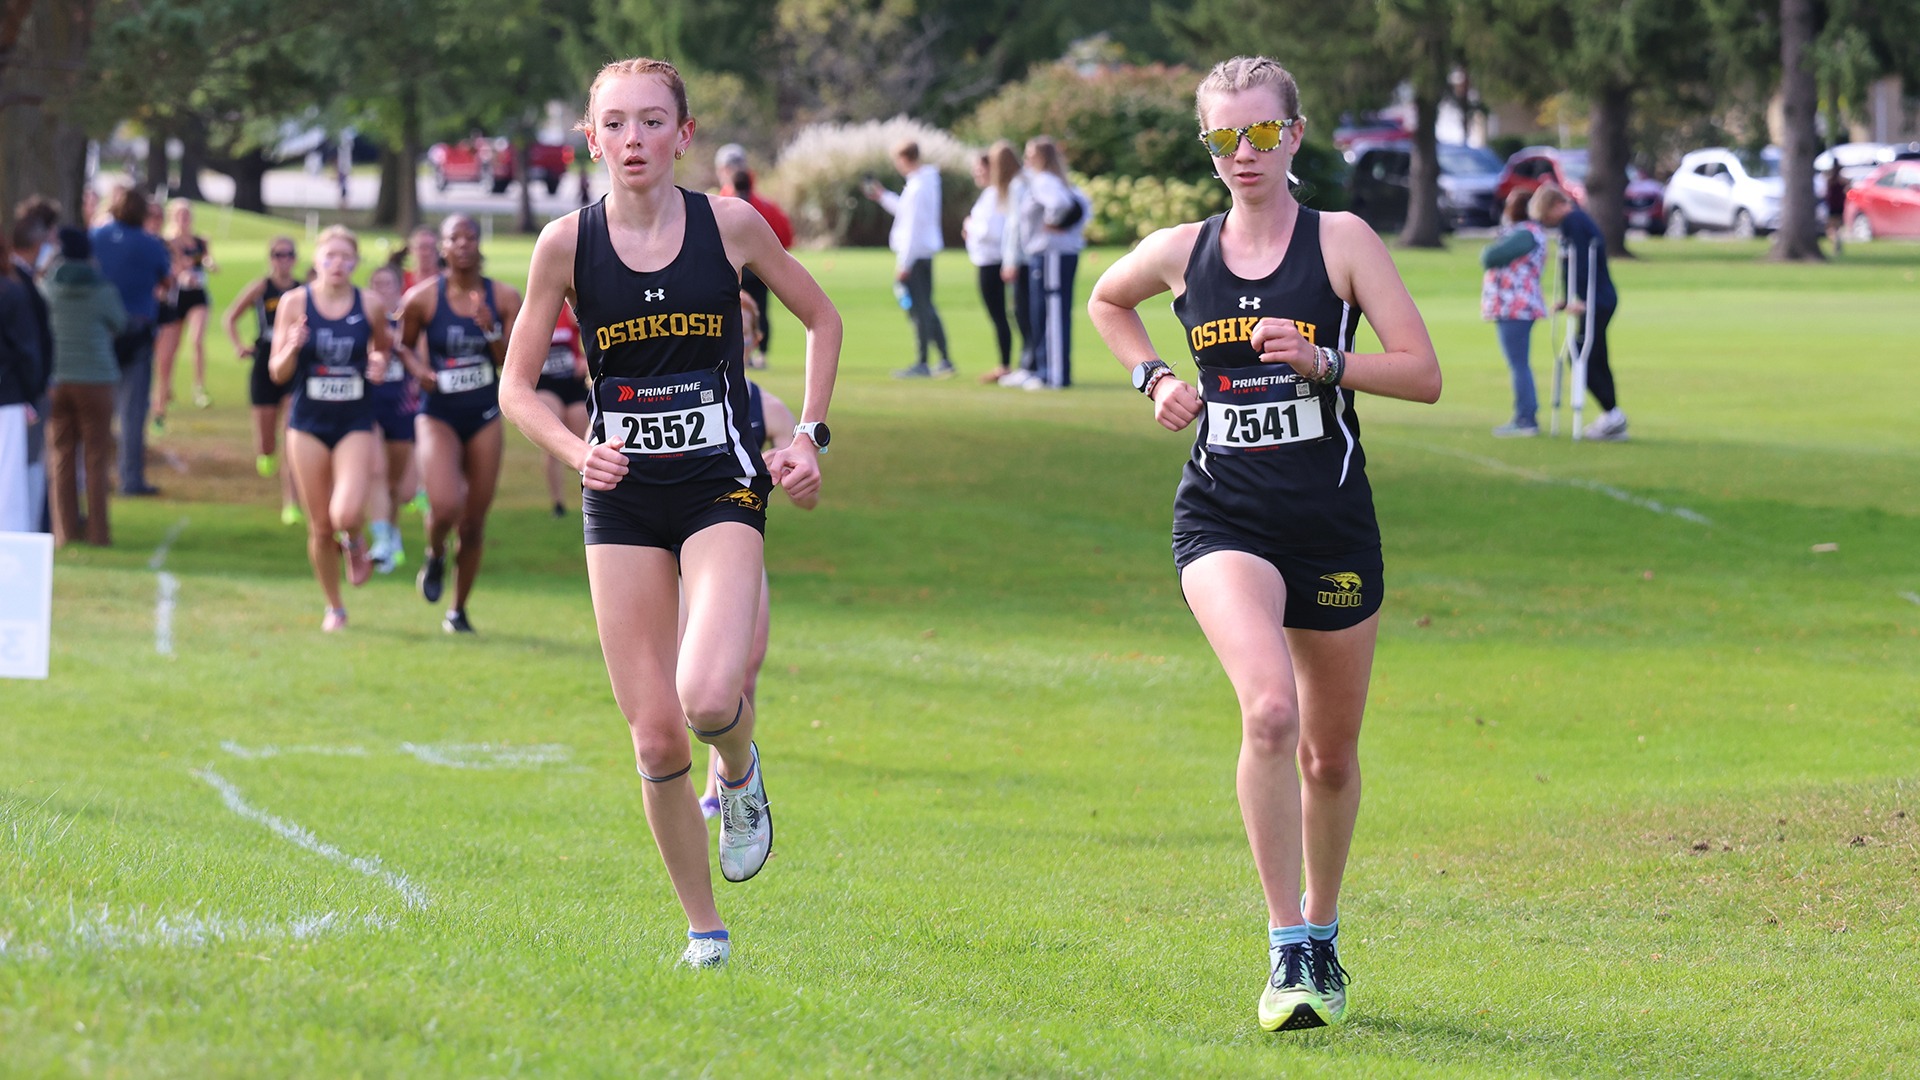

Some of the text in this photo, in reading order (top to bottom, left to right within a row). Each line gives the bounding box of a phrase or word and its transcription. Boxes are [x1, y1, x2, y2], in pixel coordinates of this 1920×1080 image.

[596, 313, 723, 350] OSHKOSH
[1191, 317, 1317, 351] OSHKH
[637, 381, 701, 397] PRIMETIME
[1232, 374, 1297, 388] PRIMETIME
[1233, 386, 1267, 394] TIMING
[622, 411, 707, 450] 2552
[1224, 404, 1299, 442] 2541
[1317, 590, 1362, 607] UWO
